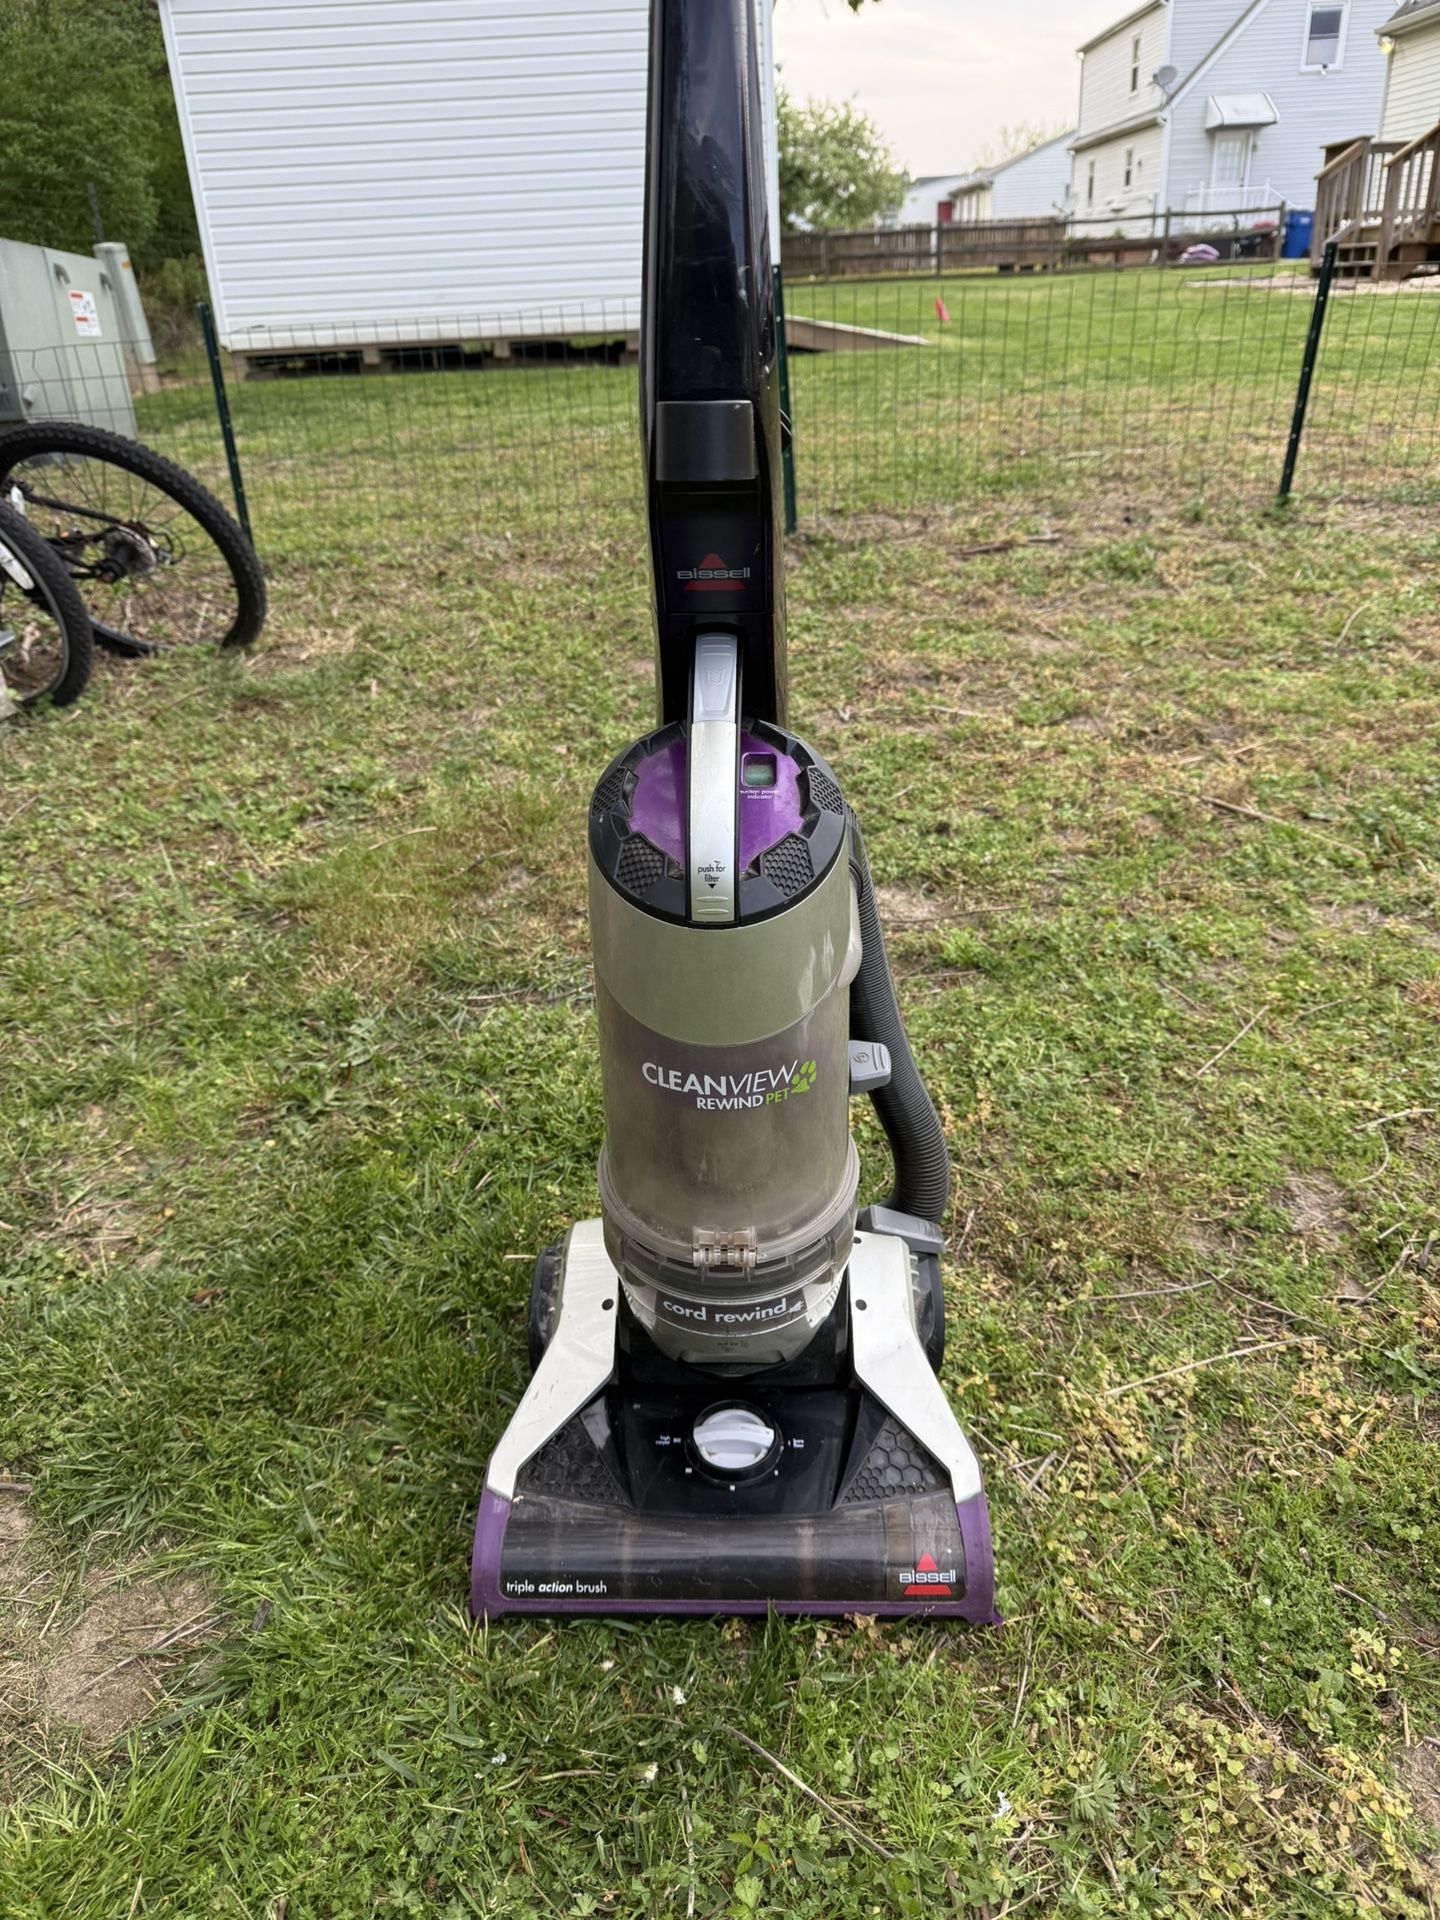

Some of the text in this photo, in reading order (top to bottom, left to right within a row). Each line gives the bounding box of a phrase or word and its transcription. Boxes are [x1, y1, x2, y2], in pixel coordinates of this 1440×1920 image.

[697, 863, 715, 875] push
[704, 873, 720, 883] filter
[663, 1297, 787, 1324] cord rewind
[506, 1579, 607, 1596] triple action brush
